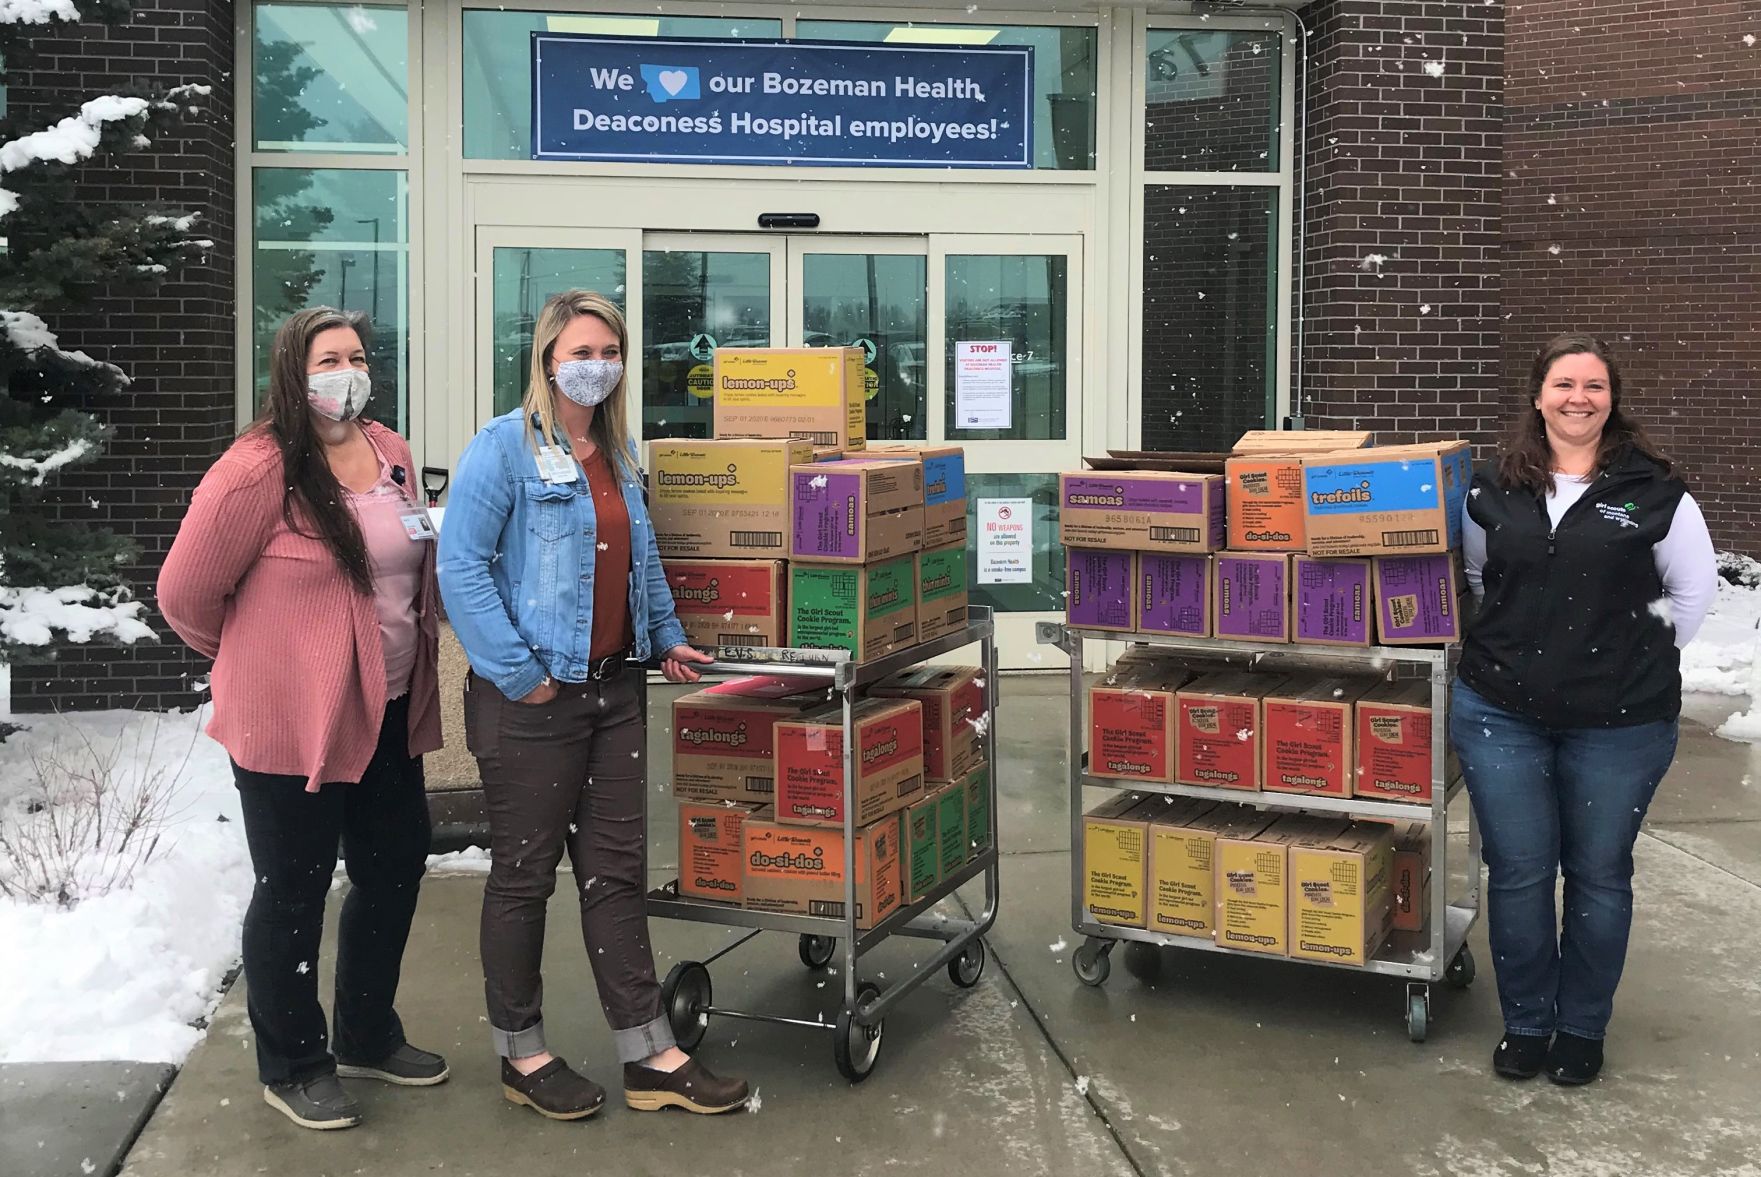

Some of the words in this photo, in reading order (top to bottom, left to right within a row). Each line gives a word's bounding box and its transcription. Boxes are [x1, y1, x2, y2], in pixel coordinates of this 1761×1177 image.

[590, 67, 634, 91] We
[709, 76, 755, 96] our
[763, 72, 887, 97] Bozeman
[895, 76, 982, 101] Health
[573, 107, 723, 134] Deaconess
[731, 111, 842, 140] Hospital
[850, 115, 998, 143] employees!
[969, 345, 997, 353] STOP!
[722, 375, 797, 393] lemon-ups
[657, 469, 738, 489] lemon-ups
[1068, 493, 1125, 507] samoas
[1311, 487, 1372, 504] trefoils
[987, 522, 997, 532] NO
[1245, 530, 1291, 542] do-si-dos
[671, 584, 719, 604] alongs
[797, 608, 810, 616] The
[810, 608, 824, 616] Girl
[824, 609, 844, 617] Scout
[797, 615, 820, 623] Cookie
[820, 616, 852, 626] Program.
[680, 727, 747, 748] tagalongs
[1106, 760, 1152, 775] tagalongs
[1194, 767, 1239, 782] tagalongs
[1281, 773, 1328, 789] tagalongs
[1374, 778, 1423, 794] tagalongs
[750, 850, 825, 870] do-si-dos
[1159, 879, 1169, 887] The
[1169, 880, 1180, 888] Girl
[1090, 903, 1136, 920] lemon-ups
[1157, 912, 1206, 930] lemon-ups
[1226, 929, 1277, 946] lemon-ups
[1300, 939, 1353, 957] lemon-ups
